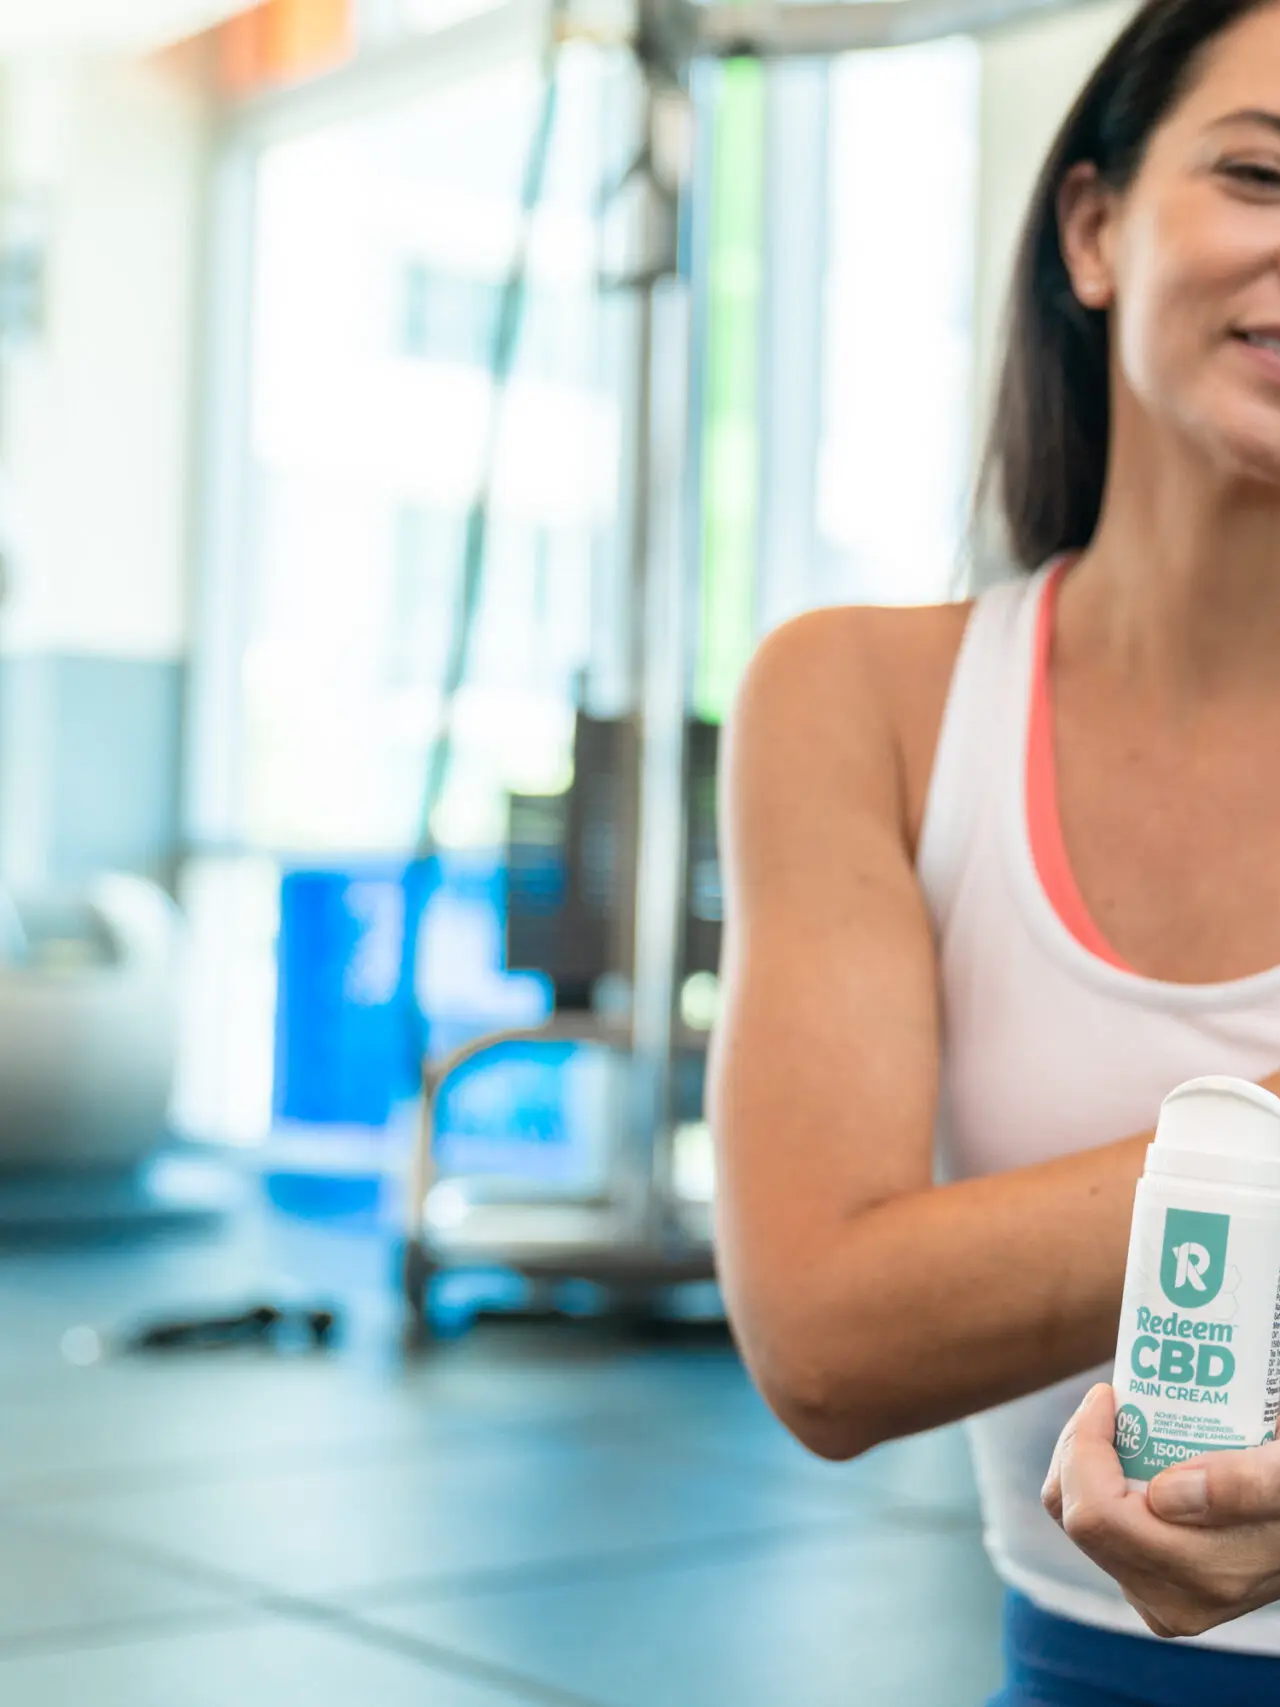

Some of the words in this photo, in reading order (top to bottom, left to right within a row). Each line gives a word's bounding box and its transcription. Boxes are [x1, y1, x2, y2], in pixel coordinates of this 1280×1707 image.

[1136, 1306, 1233, 1342] Redeem
[1130, 1334, 1236, 1388] CBD
[1129, 1379, 1160, 1397] PAIN
[1165, 1386, 1229, 1405] CREAM
[1117, 1411, 1142, 1435] 0%
[1116, 1431, 1141, 1450] THC
[1152, 1441, 1206, 1460] 1500m
